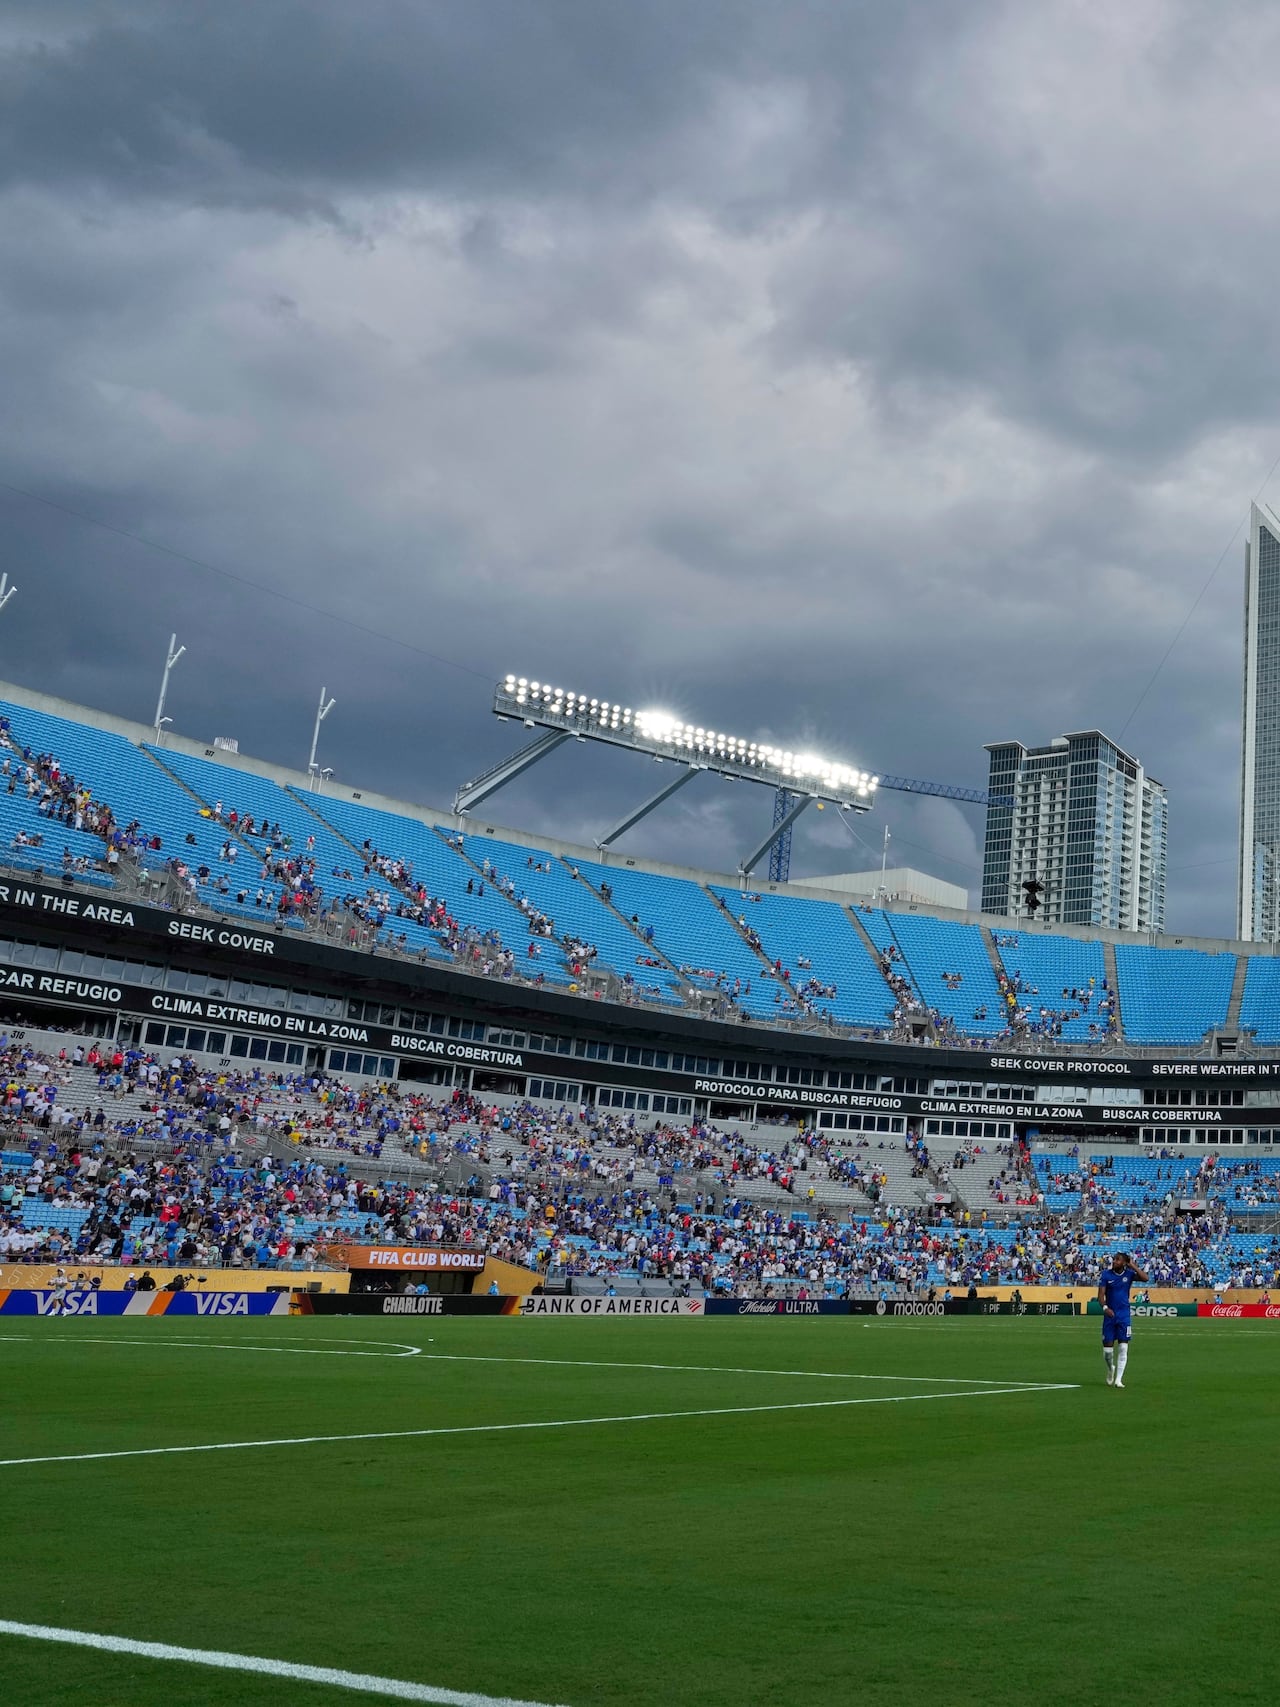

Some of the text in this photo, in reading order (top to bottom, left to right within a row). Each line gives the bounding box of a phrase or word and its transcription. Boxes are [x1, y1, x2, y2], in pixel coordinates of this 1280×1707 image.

[15, 890, 35, 906] IN
[42, 895, 79, 915] THE
[82, 902, 136, 926] AREA
[168, 919, 276, 954] SEEK COVER
[38, 976, 122, 1001] REFUGIO
[151, 995, 368, 1043] CLIMA EXTREMO EN LA ZONA
[10, 1031, 25, 1039] 316
[391, 1035, 523, 1066] BUSCAR COBERTURA
[219, 1058, 231, 1067] 317
[991, 1058, 1130, 1073] SEEK COVER PROTOCOL
[1152, 1065, 1197, 1074] SEVERE
[1201, 1065, 1256, 1074] WEATHER
[1259, 1065, 1269, 1074] IN
[695, 1080, 901, 1109] PROTOCOLO PARA BUSCAR REFUGIO
[920, 1101, 1083, 1118] CLIMA EXTREMO EN LA ZONA
[1103, 1110, 1221, 1120] BUSCAR COBERTURA
[368, 1251, 486, 1268] FIFA CLUB WORLD
[192, 1293, 249, 1315] VISA
[382, 1296, 443, 1314] CHARLOTTE
[526, 1298, 680, 1314] BANK OF AMERICA
[738, 1300, 819, 1314] Michelob ULTRA
[893, 1301, 945, 1316] motorola
[989, 1304, 1000, 1313] PIF
[1046, 1304, 1060, 1313] PIF
[1130, 1305, 1178, 1317] sense
